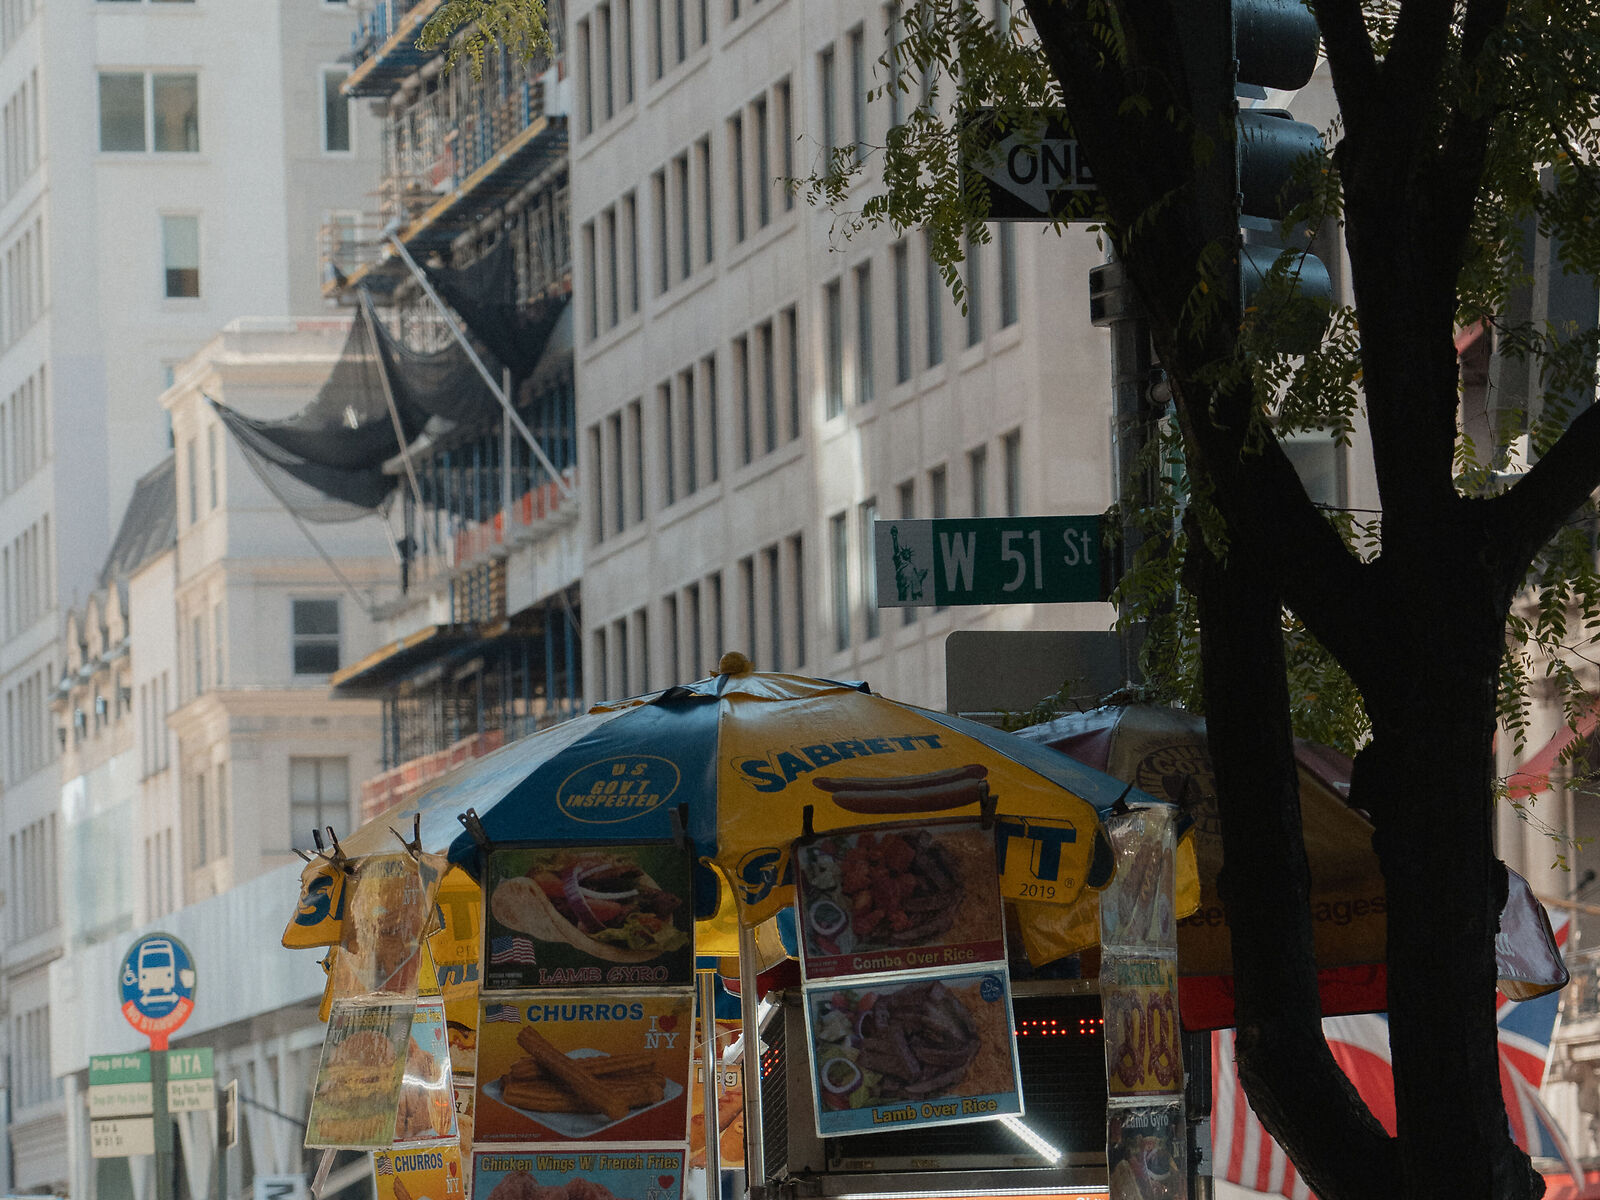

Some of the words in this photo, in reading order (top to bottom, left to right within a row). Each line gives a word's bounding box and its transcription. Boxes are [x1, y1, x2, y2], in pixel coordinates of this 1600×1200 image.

[939, 531, 977, 592] W
[1000, 530, 1043, 591] 51
[1063, 526, 1092, 565] St
[740, 734, 943, 793] SABRETT
[565, 794, 660, 807] INSPECTED
[1019, 883, 1056, 899] 2019
[853, 955, 901, 971] Combo
[906, 952, 939, 965] Over
[943, 948, 975, 962] Rice
[538, 967, 601, 984] LAMB
[606, 965, 669, 982] GYRO
[526, 1003, 644, 1022] CHURROS
[648, 1015, 659, 1033] I
[644, 1032, 680, 1049] NY
[169, 1055, 203, 1075] MTA
[872, 1104, 917, 1124] Lamb
[921, 1102, 958, 1118] Over
[962, 1098, 997, 1115] Rice
[395, 1153, 443, 1173] CHURROS
[481, 1156, 532, 1171] Chicken
[537, 1156, 575, 1172] Wings
[600, 1155, 643, 1170] French
[647, 1154, 679, 1169] Fries
[446, 1177, 459, 1194] NY
